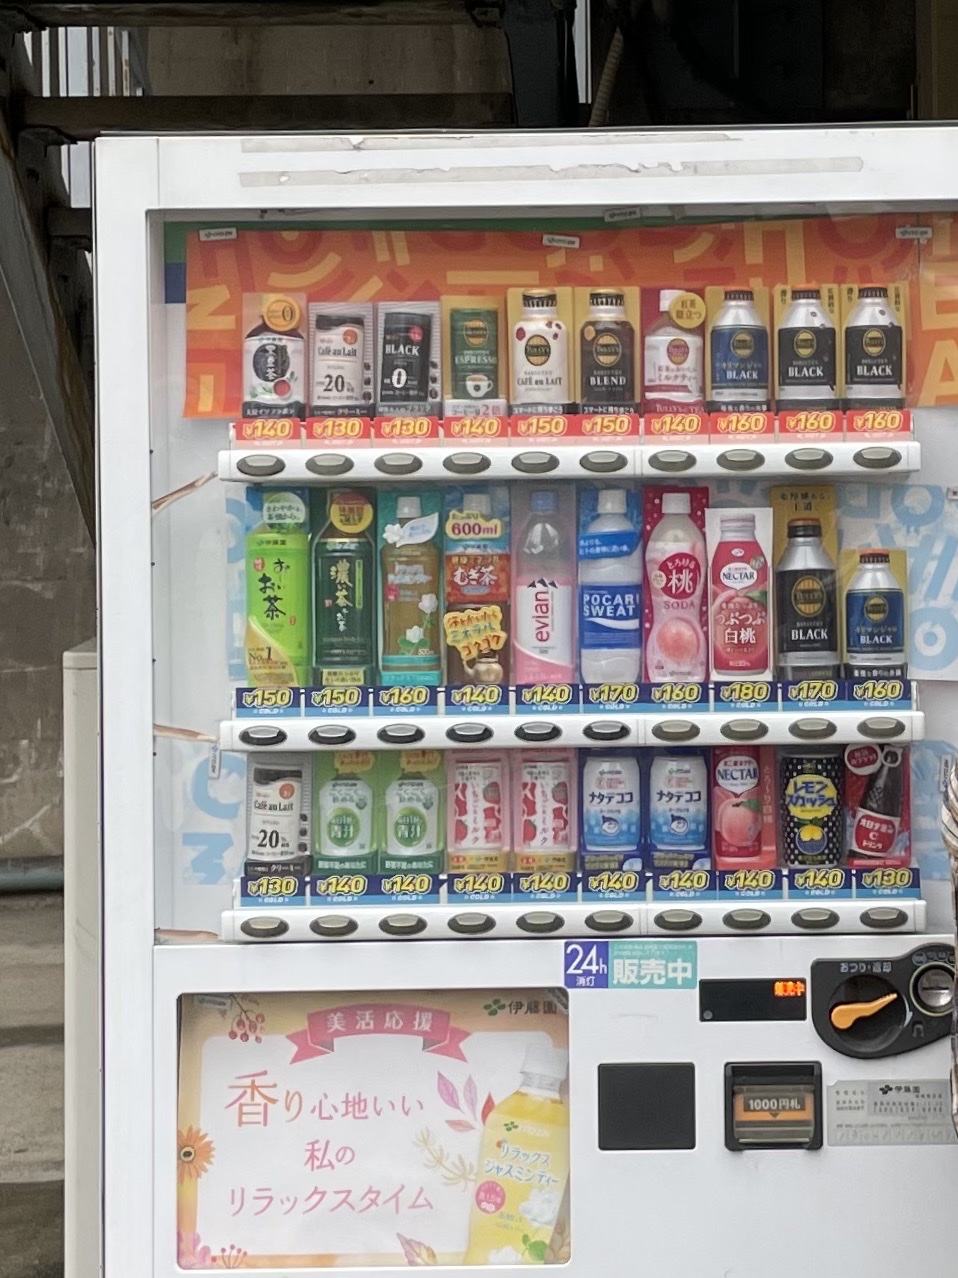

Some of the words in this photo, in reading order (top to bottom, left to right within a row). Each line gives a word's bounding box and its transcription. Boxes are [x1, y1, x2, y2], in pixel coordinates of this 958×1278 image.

[317, 345, 331, 357] Café
[332, 348, 342, 357] au
[342, 346, 357, 357] Lait
[384, 344, 420, 357] BLACK
[455, 356, 497, 365] ESPRESSO
[391, 368, 408, 388] 0
[726, 370, 759, 380] BLACK
[788, 366, 824, 377] BLACK
[857, 365, 893, 376] BLACK
[323, 374, 345, 393] 20
[545, 377, 562, 386] LAIT
[590, 376, 626, 386] BLEND
[245, 420, 291, 436] ¥140
[314, 419, 361, 436] ¥130
[383, 418, 429, 435] ¥130
[453, 418, 499, 434] ¥140
[519, 416, 566, 434] ¥150
[583, 416, 630, 434] ¥150
[652, 415, 700, 433] ¥140
[718, 415, 765, 432] ¥160
[787, 412, 834, 431] ¥160
[855, 411, 901, 430] ¥160
[451, 523, 498, 536] 600ml
[666, 561, 695, 569] とろける
[453, 565, 498, 586] むぎ茶
[667, 570, 694, 595] 桃
[722, 572, 756, 581] NECTAR
[258, 573, 286, 621] お茶
[583, 594, 640, 606] POCARI
[663, 600, 696, 611] SODA
[534, 590, 549, 643] evian
[583, 605, 636, 617] SWEAT
[715, 612, 767, 626] つぶつぶ
[451, 624, 496, 640] ミネラル
[725, 628, 756, 644] 白桃
[791, 628, 829, 641] BLACK
[860, 635, 893, 644] BLACK
[244, 689, 292, 706] ¥150
[313, 688, 360, 705] ¥150
[381, 687, 428, 704] ¥160
[453, 686, 500, 703] ¥140
[523, 686, 571, 703] ¥140
[591, 685, 638, 702] ¥170
[653, 685, 700, 702] ¥160
[722, 684, 769, 701] ¥180
[789, 682, 836, 700] ¥170
[855, 681, 902, 699] ¥160
[794, 781, 827, 794] レモン
[254, 800, 267, 810] Café
[268, 803, 278, 811] au
[278, 801, 293, 811] Lait
[589, 791, 633, 804] ナタデココ
[656, 790, 701, 804] ナタデココ
[786, 794, 836, 807] スカッシュ
[331, 825, 353, 839] 青汁
[398, 824, 421, 839] 青汁
[859, 818, 895, 833] オロナミン
[257, 829, 279, 849] 20
[869, 831, 878, 841] C
[862, 840, 883, 850] ドリンク
[248, 876, 297, 895] ¥130
[317, 876, 367, 894] ¥140
[383, 874, 431, 892] ¥140
[455, 874, 503, 891] ¥140
[520, 874, 569, 891] ¥140
[589, 872, 638, 890] ¥140
[659, 871, 709, 889] ¥140
[725, 870, 775, 888] ¥140
[795, 869, 844, 887] ¥140
[862, 868, 911, 887] ¥130
[565, 943, 608, 975] 24h
[840, 961, 892, 973] おつり・返却
[612, 957, 693, 986] 販売中
[575, 975, 596, 987] 消灯
[326, 1010, 434, 1034] 美活応援
[224, 1069, 425, 1128] 香り心地いい
[748, 1098, 801, 1111] 1000円札
[304, 1139, 356, 1173] 私の
[501, 1143, 551, 1168] リラックス
[484, 1159, 560, 1186] ジャスミンティー
[229, 1184, 435, 1218] リラックスタイム
